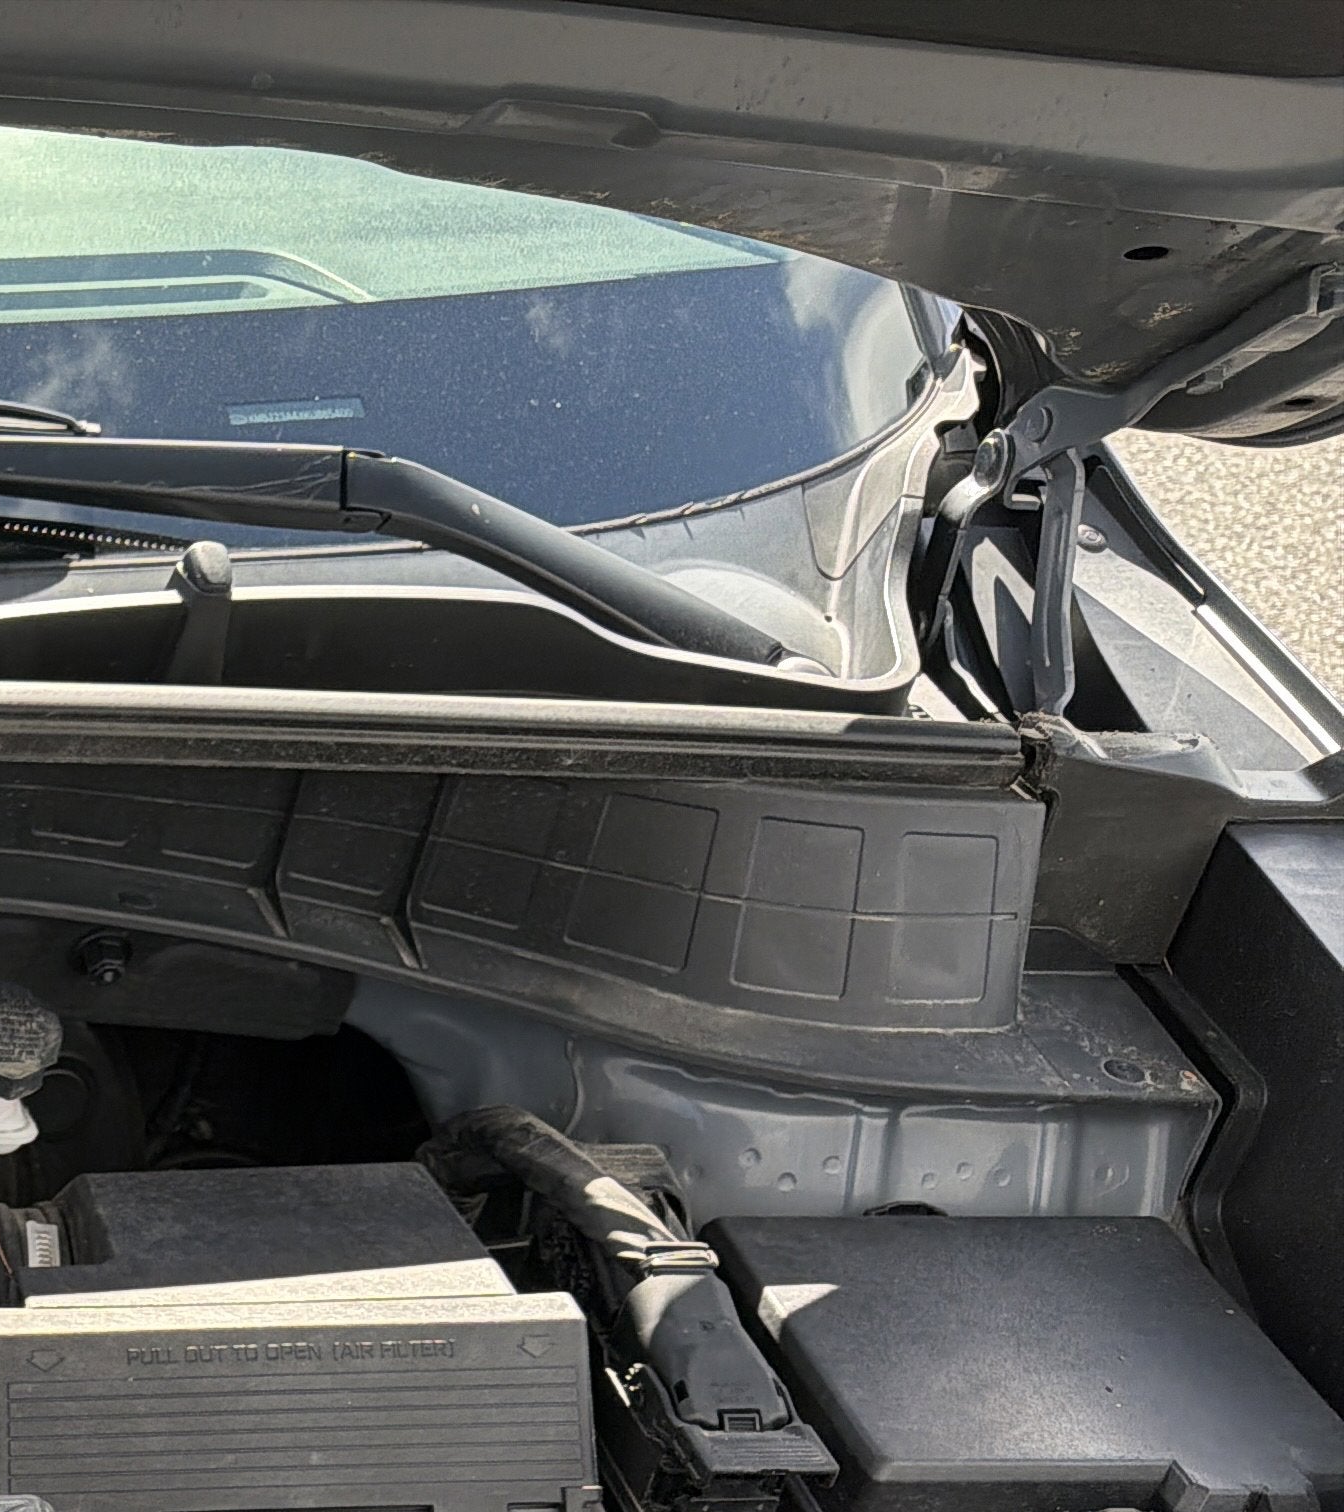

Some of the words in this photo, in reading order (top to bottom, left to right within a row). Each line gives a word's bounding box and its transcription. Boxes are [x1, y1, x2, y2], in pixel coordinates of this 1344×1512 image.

[127, 1348, 178, 1365] PULL
[185, 1345, 228, 1363] OUT
[232, 1343, 258, 1361] TO
[266, 1342, 322, 1361] OPEN
[382, 1338, 456, 1359] FILTER)
